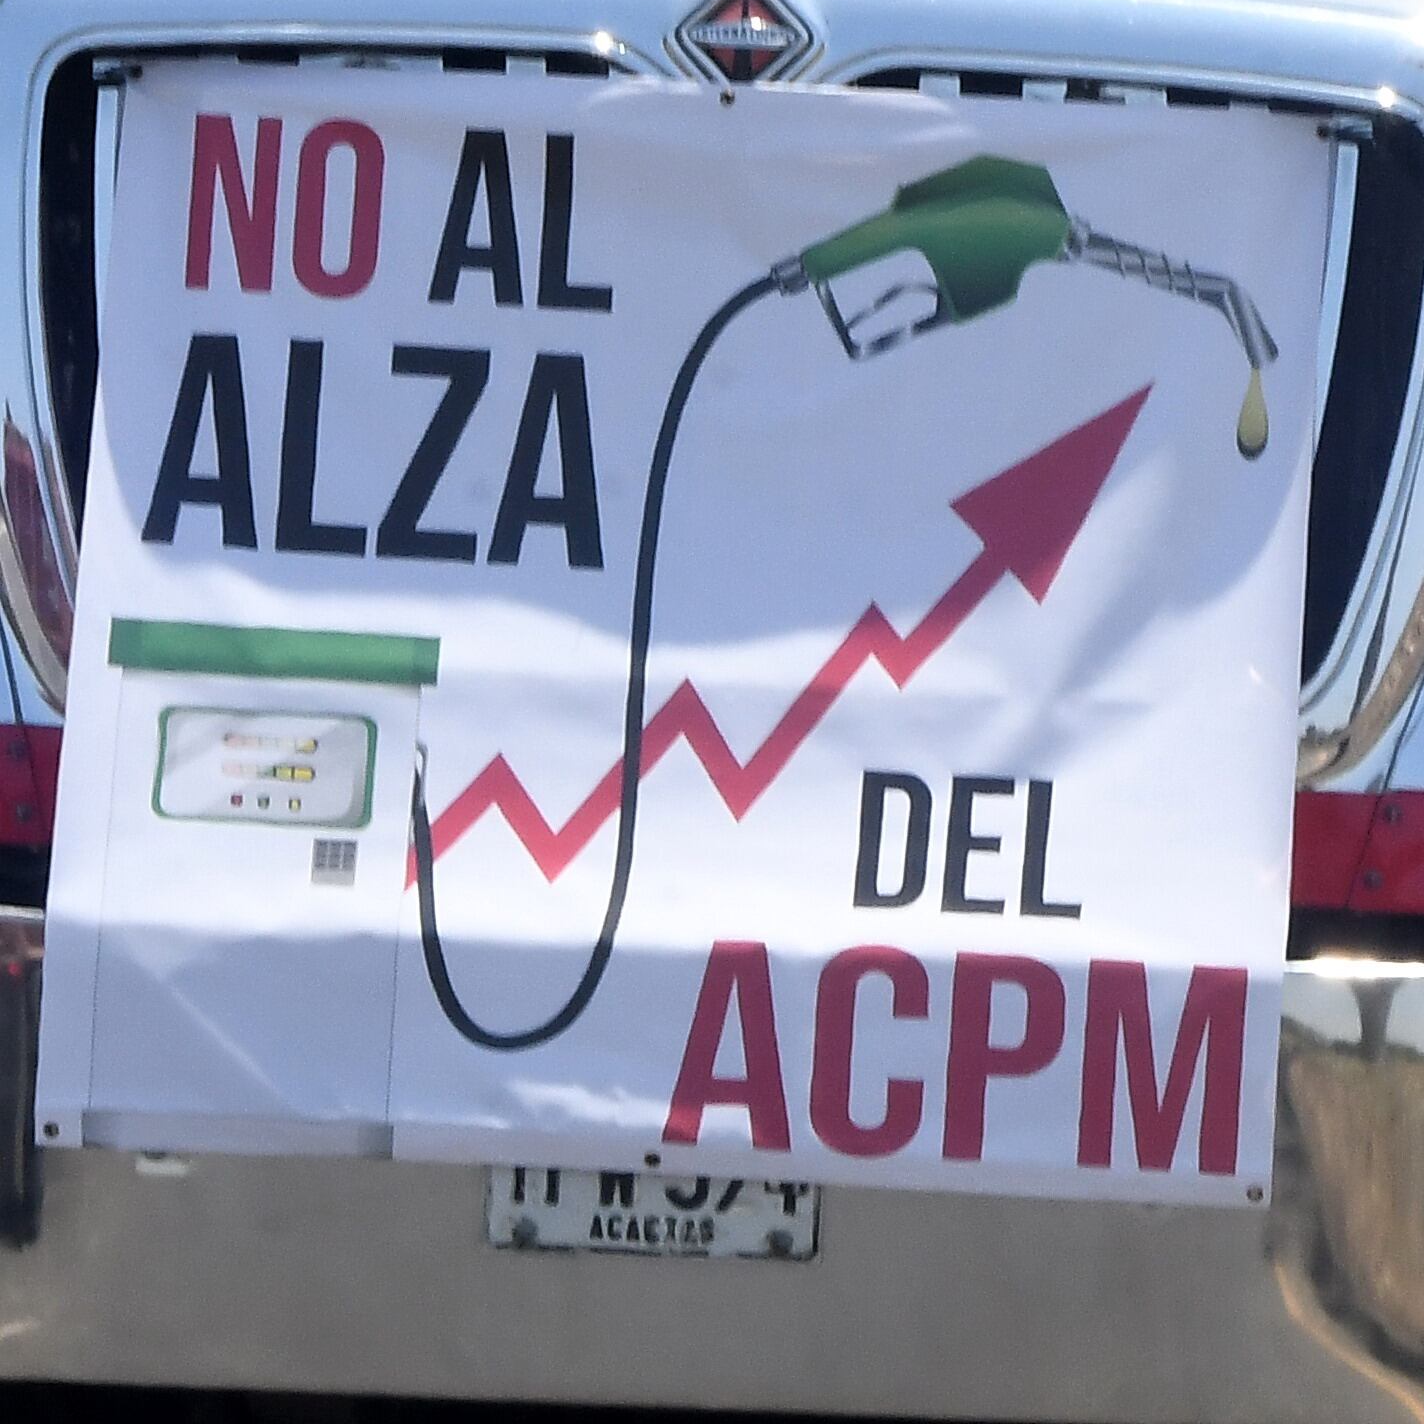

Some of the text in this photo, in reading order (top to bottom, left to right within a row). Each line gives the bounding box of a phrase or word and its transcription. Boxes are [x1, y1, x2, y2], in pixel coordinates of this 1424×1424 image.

[187, 114, 614, 315] NO AL
[141, 332, 605, 570] ALZA
[853, 770, 1083, 920] DEL
[662, 941, 1248, 1176] ACPM
